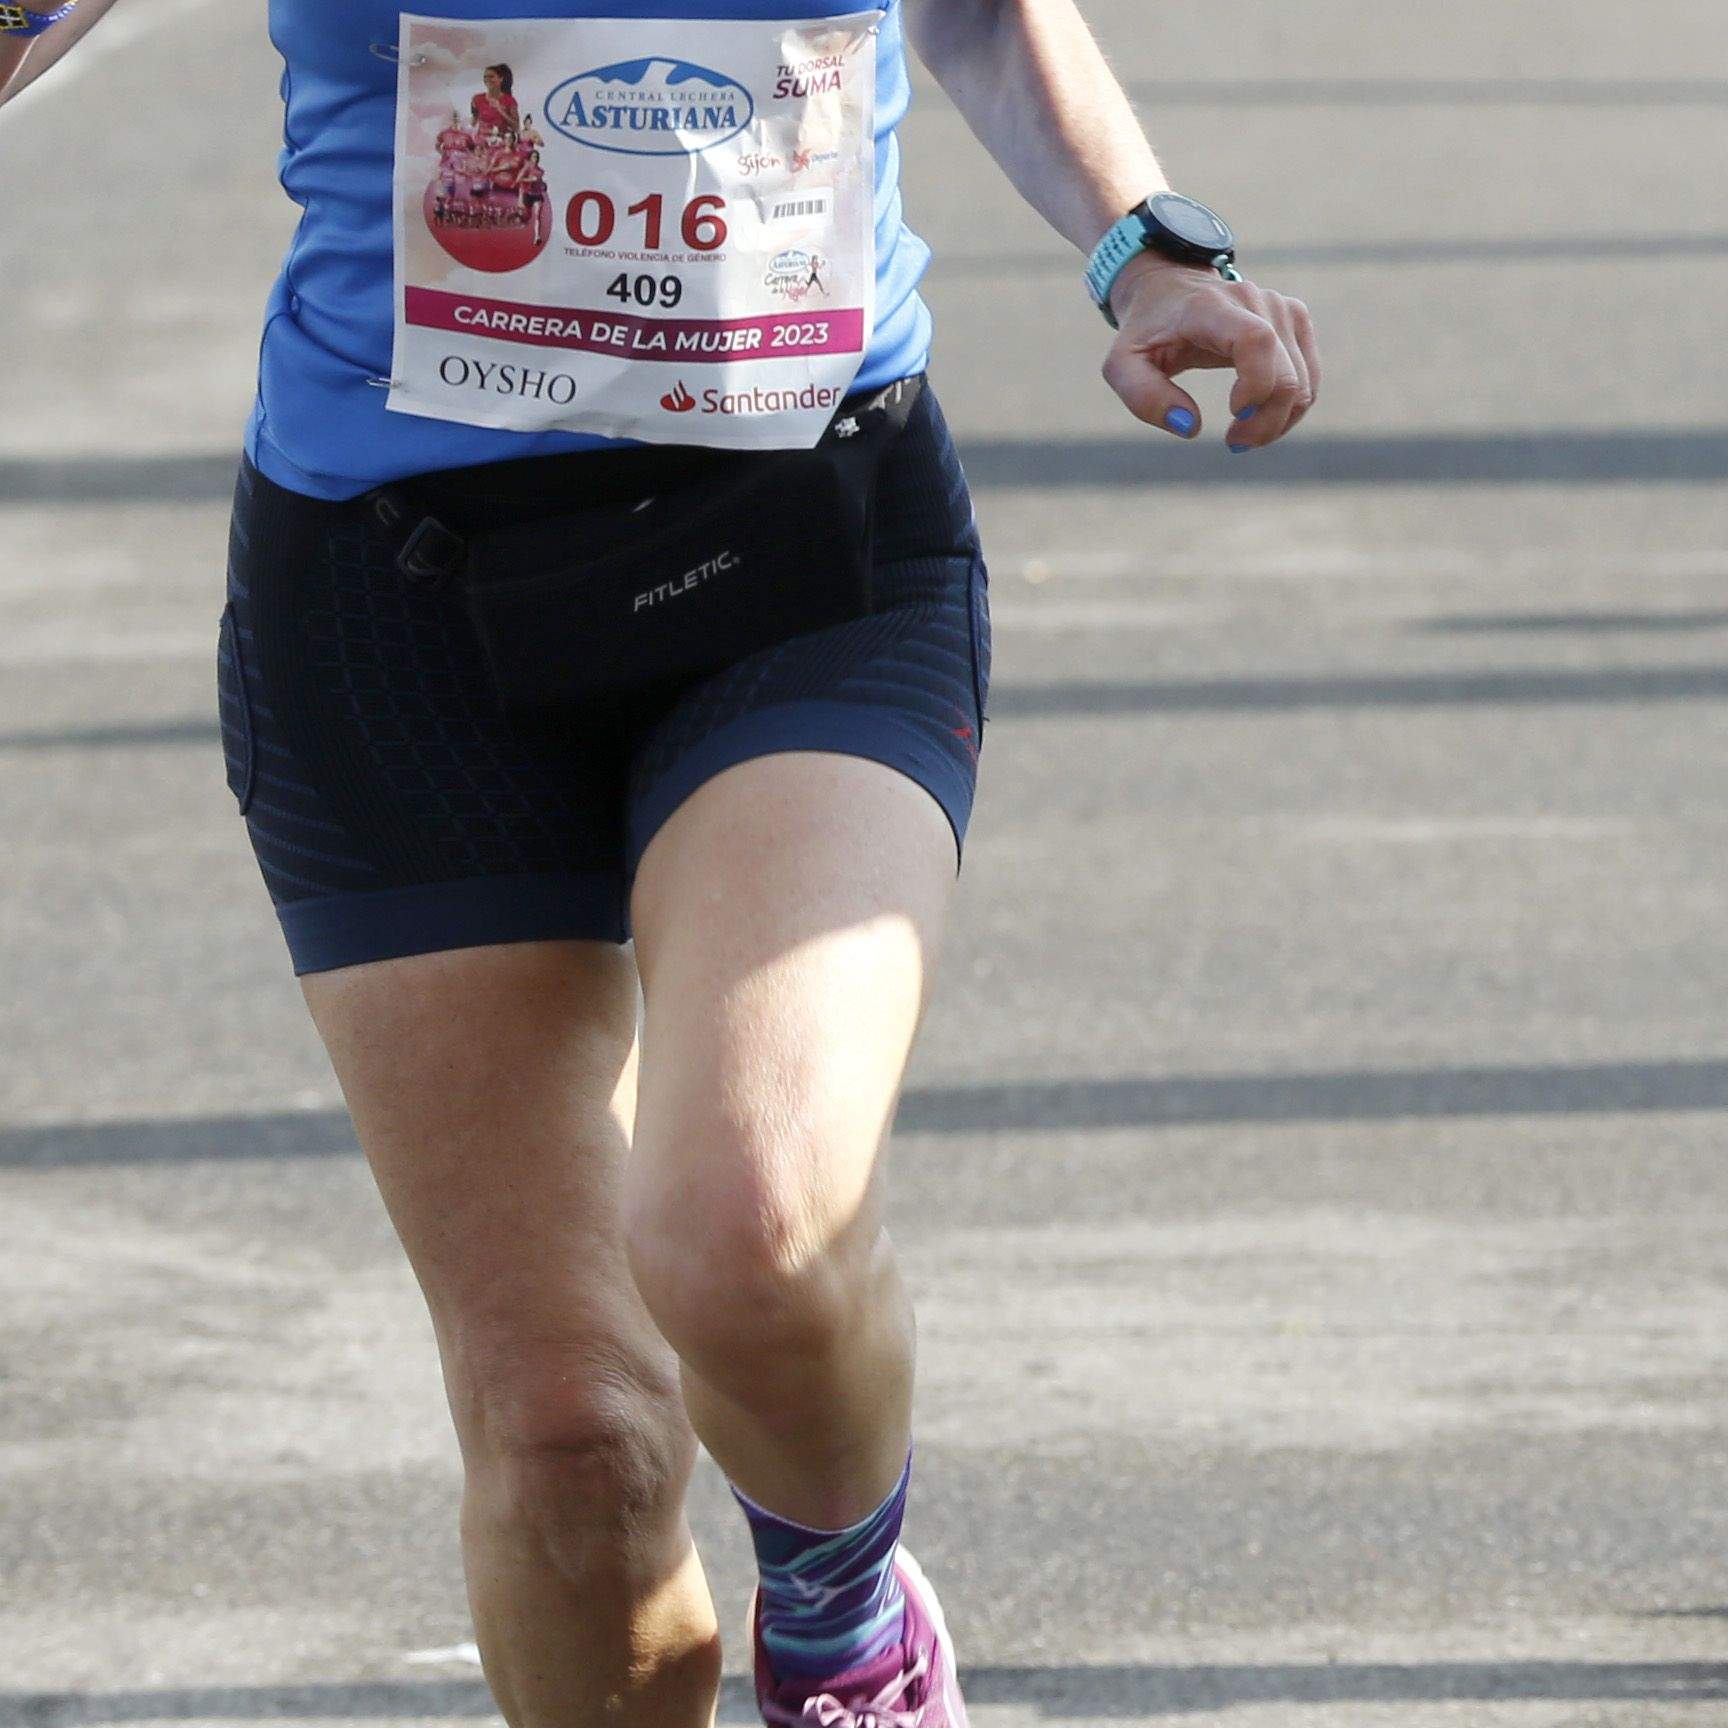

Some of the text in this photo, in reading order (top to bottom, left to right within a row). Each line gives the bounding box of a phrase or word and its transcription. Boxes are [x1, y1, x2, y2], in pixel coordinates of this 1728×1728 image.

[772, 69, 842, 100] SUMA
[776, 55, 845, 78] TU DORSAL
[559, 90, 738, 130] ASTURIANA
[595, 89, 736, 102] CENTRAL LECHERA
[565, 189, 728, 252] 016
[563, 246, 727, 264] TELÉFONO VIOLENCIA DE GÉNERO
[606, 273, 682, 309] 409
[454, 305, 830, 353] CARRERA DE LA MUJER 2023
[439, 355, 577, 405] OYSHO
[701, 383, 841, 415] Santander
[633, 550, 733, 613] FITLETIC
